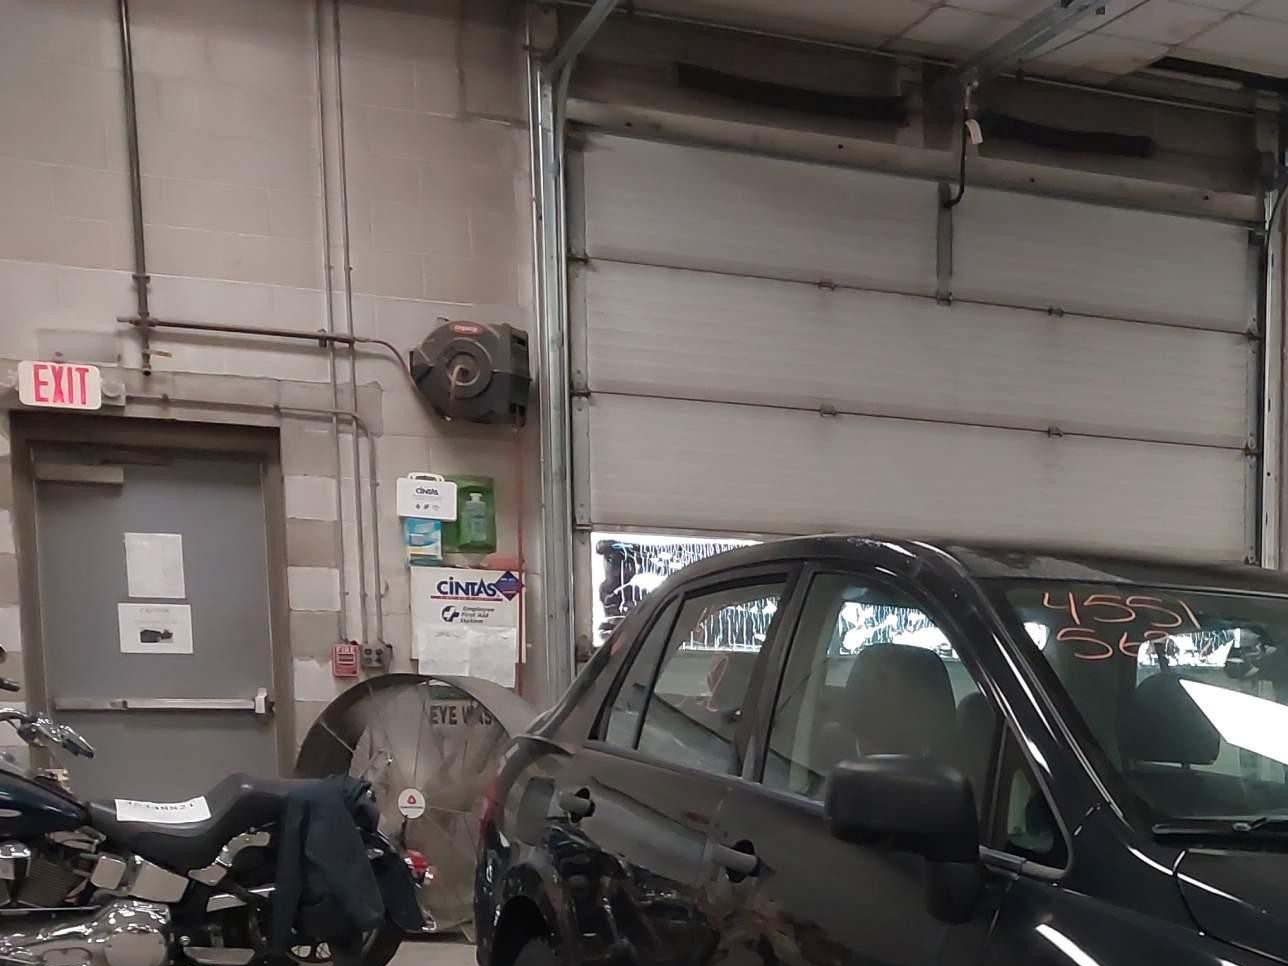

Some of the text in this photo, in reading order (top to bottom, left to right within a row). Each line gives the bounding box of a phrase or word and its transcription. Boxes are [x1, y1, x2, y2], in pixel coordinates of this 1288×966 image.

[33, 364, 89, 405] EXIT
[1043, 592, 1201, 629] 4551
[430, 704, 492, 725] EYE WS
